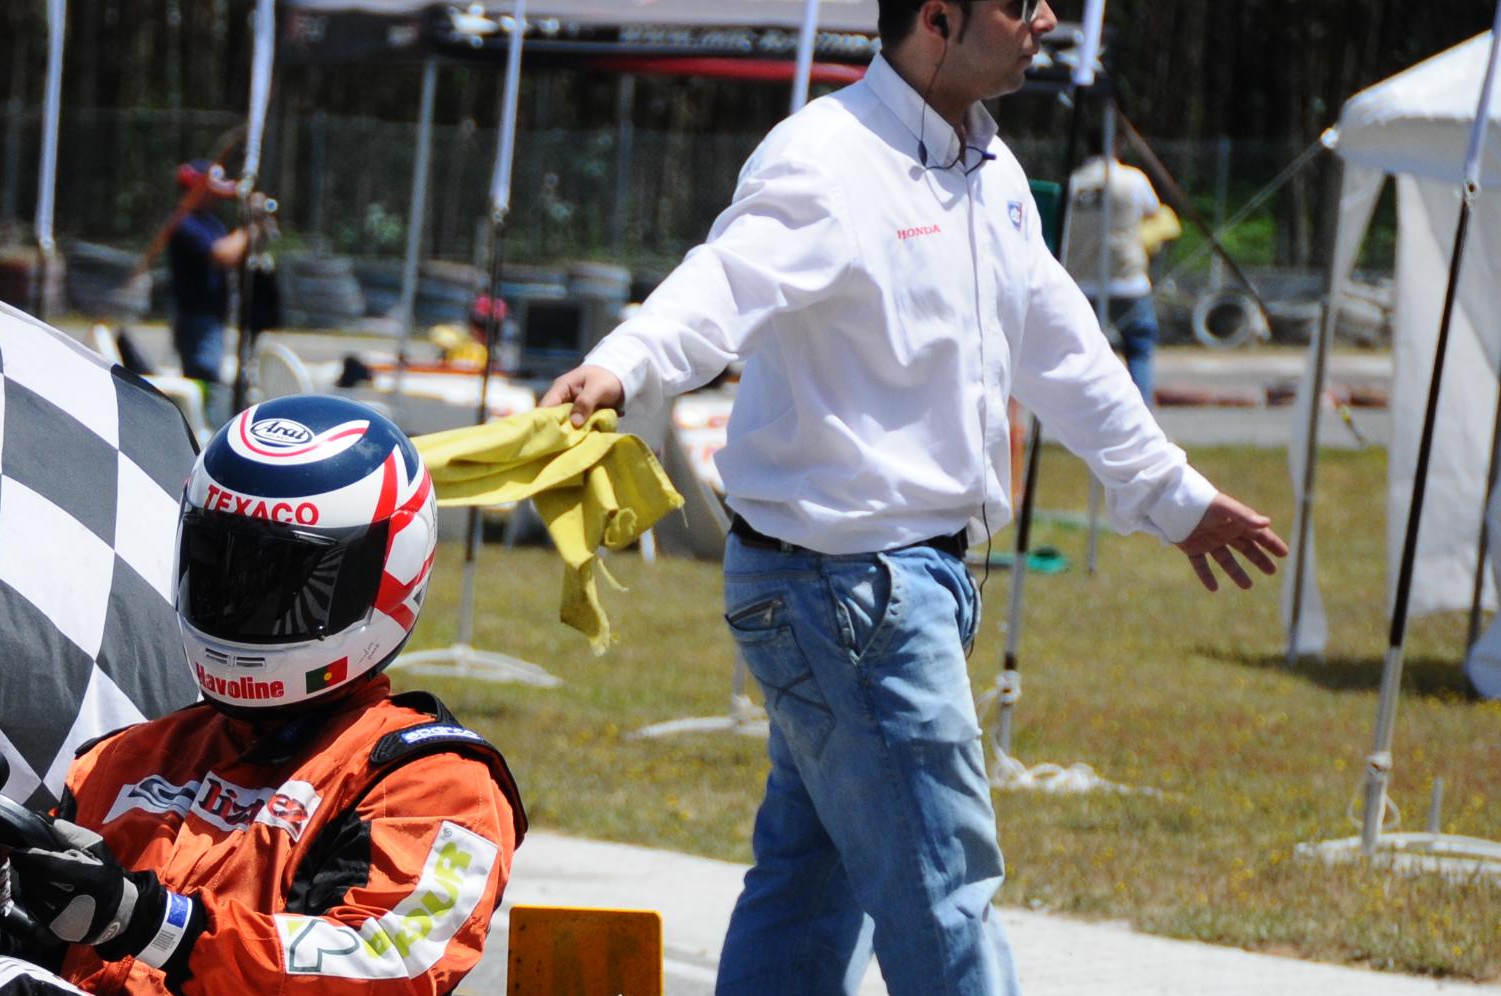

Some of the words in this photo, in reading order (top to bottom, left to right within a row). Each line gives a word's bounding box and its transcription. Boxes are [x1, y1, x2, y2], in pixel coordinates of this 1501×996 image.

[897, 224, 941, 240] HONDA
[257, 420, 307, 440] Arai
[203, 484, 319, 527] TEXACO
[195, 661, 285, 699] Havoline
